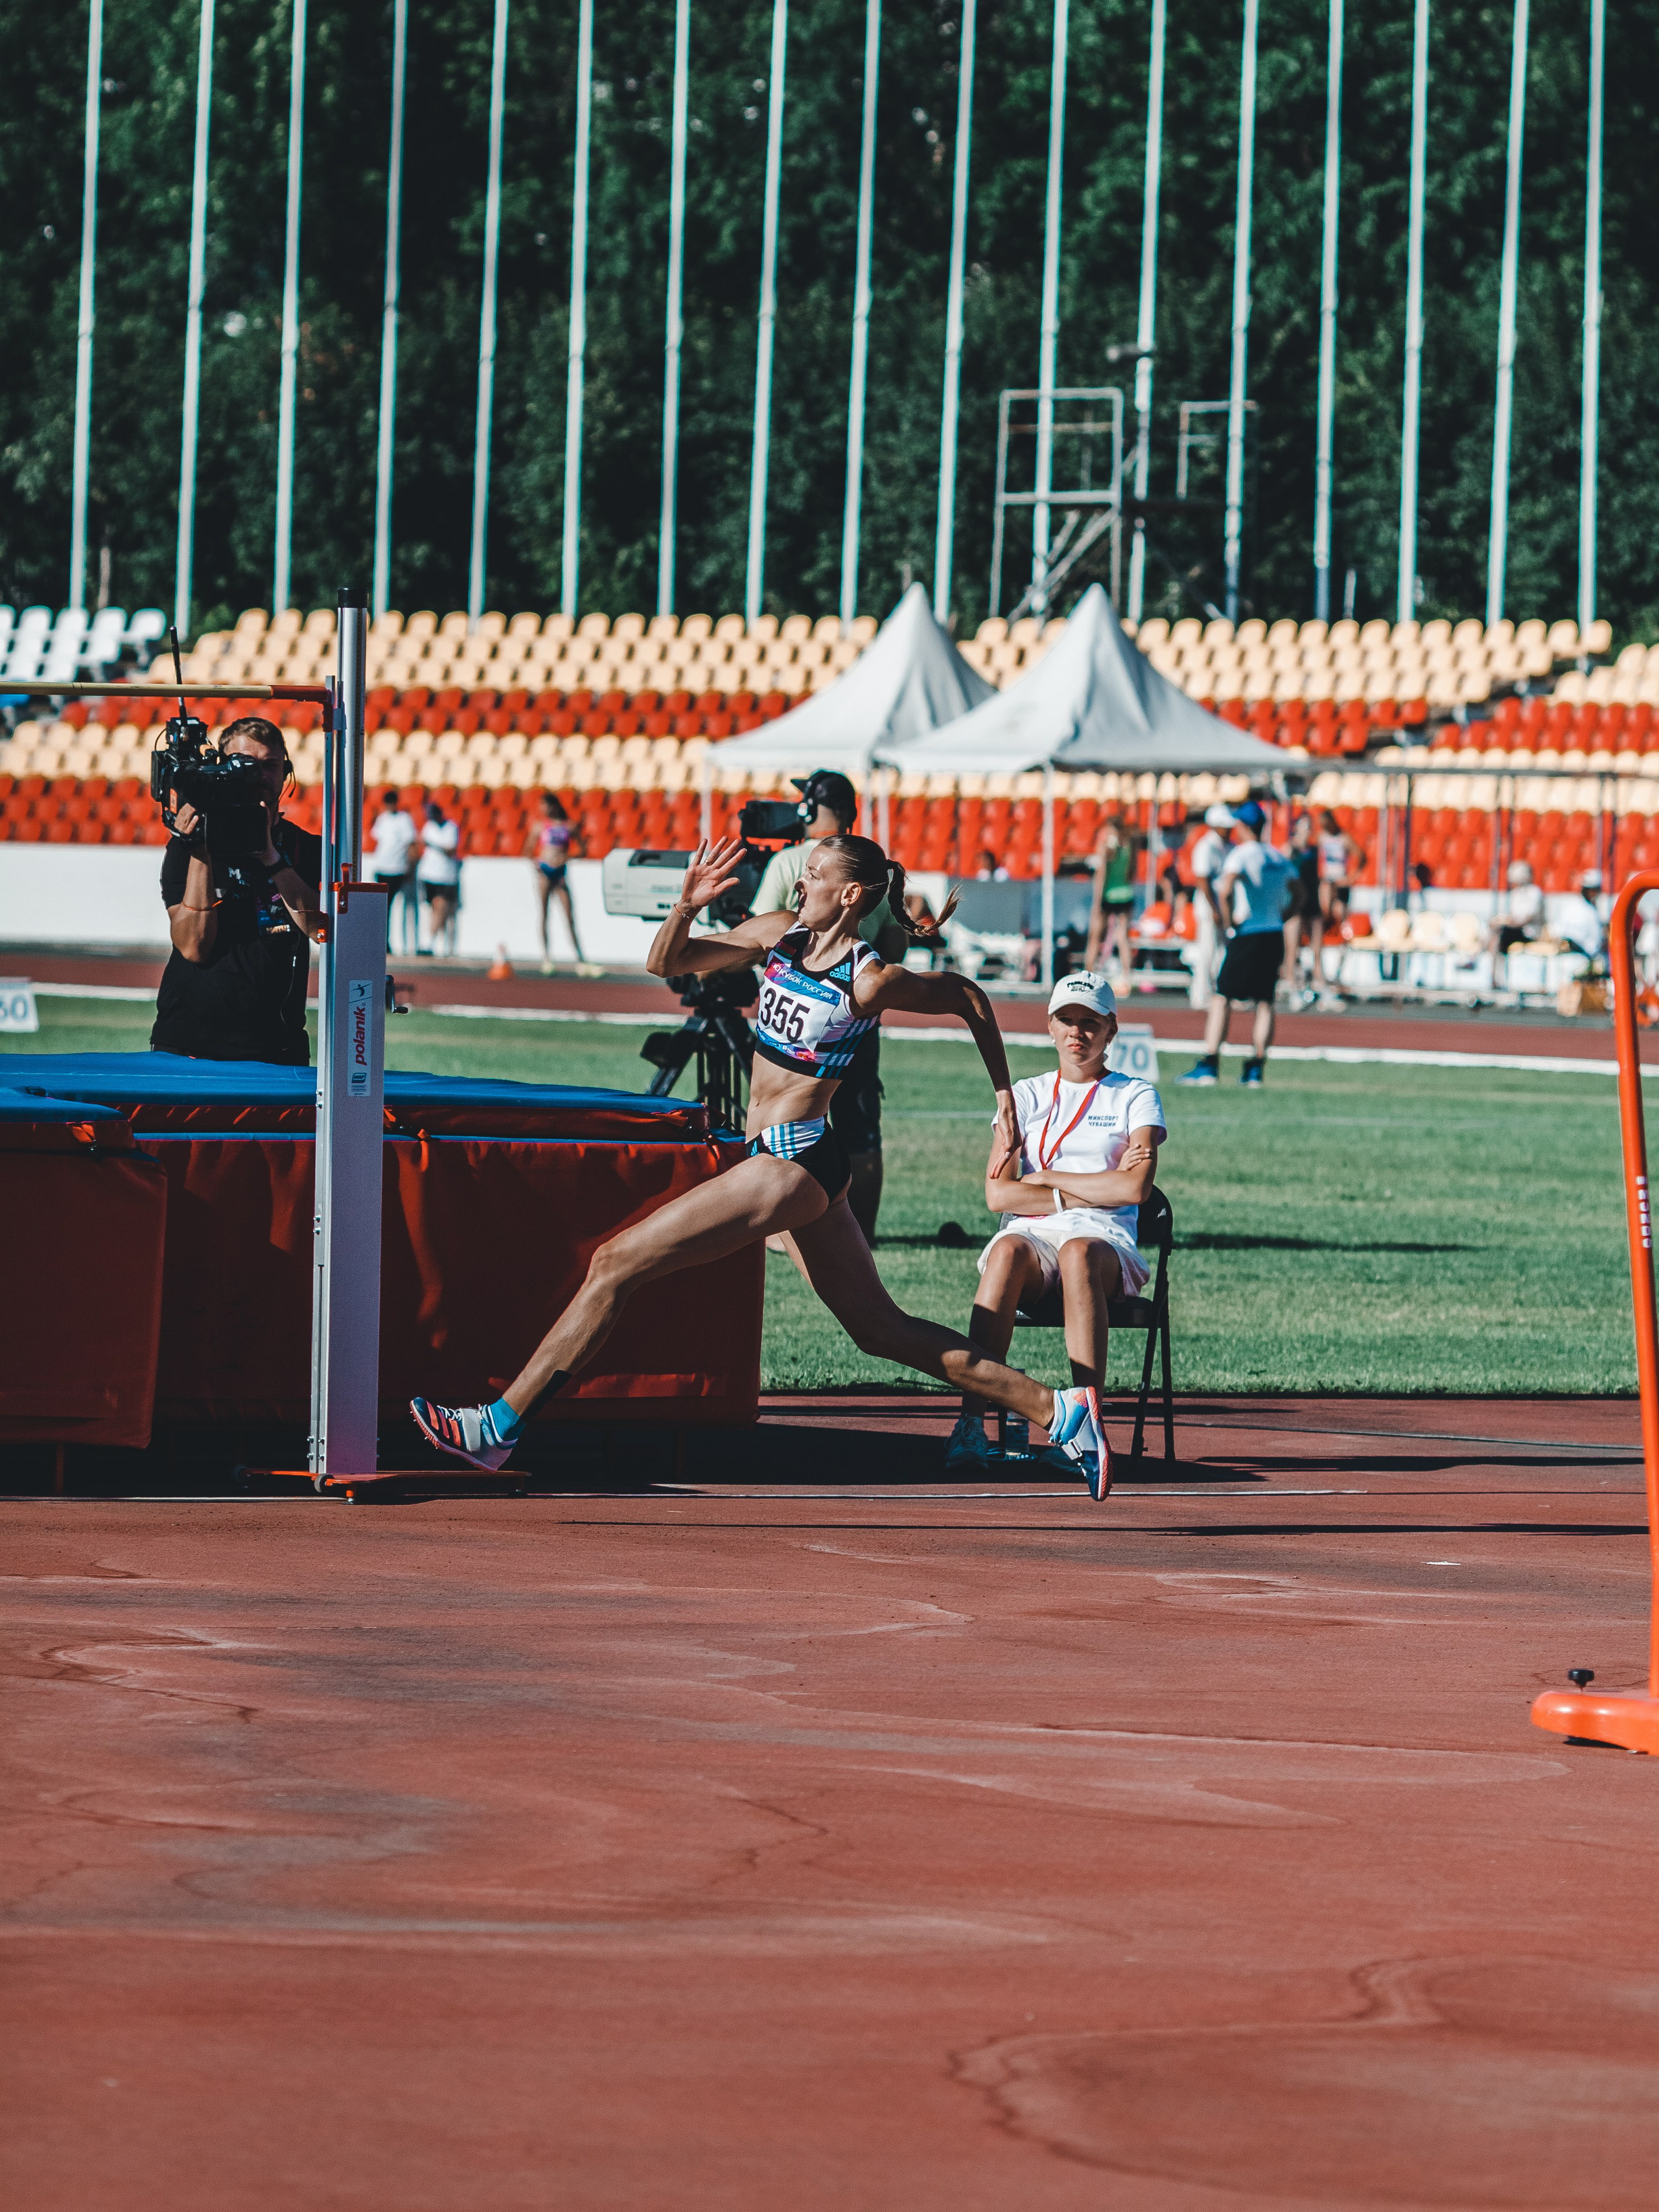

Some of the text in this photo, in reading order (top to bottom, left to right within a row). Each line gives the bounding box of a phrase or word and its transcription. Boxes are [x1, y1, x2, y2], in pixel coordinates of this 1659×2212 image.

[779, 969, 833, 999] КУБОК РОССИИ
[830, 971, 851, 982] adidas
[760, 987, 811, 1043] 355
[353, 1005, 367, 1066] polanik
[1115, 1043, 1150, 1071] 70
